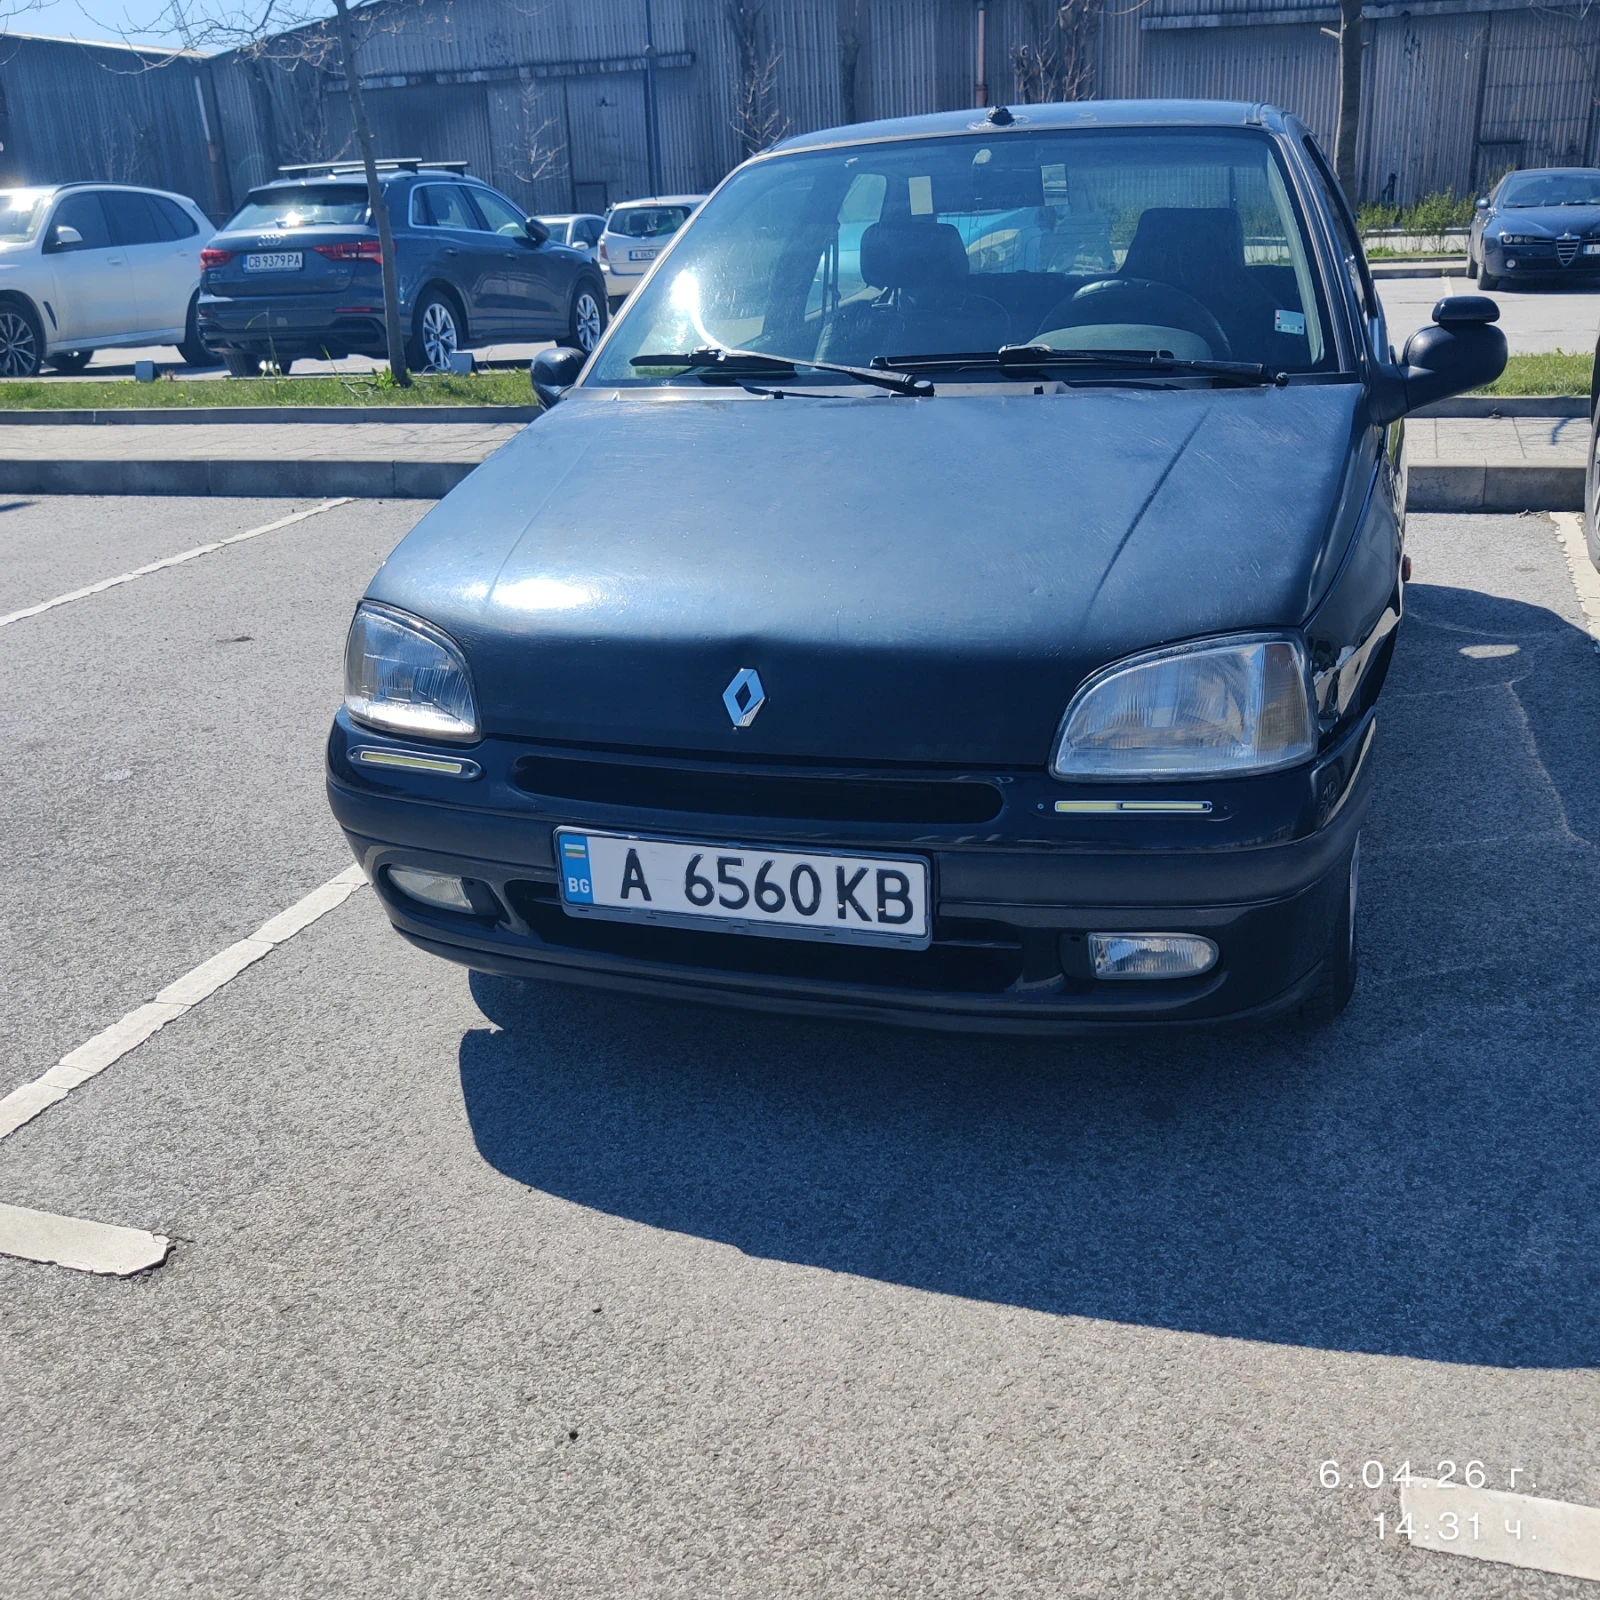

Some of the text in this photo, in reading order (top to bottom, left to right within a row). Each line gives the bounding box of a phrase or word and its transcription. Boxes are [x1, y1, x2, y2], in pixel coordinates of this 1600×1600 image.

[248, 256, 261, 268] CB
[262, 254, 286, 267] 9379
[287, 254, 301, 266] PA
[568, 877, 590, 895] BG
[620, 848, 914, 925] A 6560 KB
